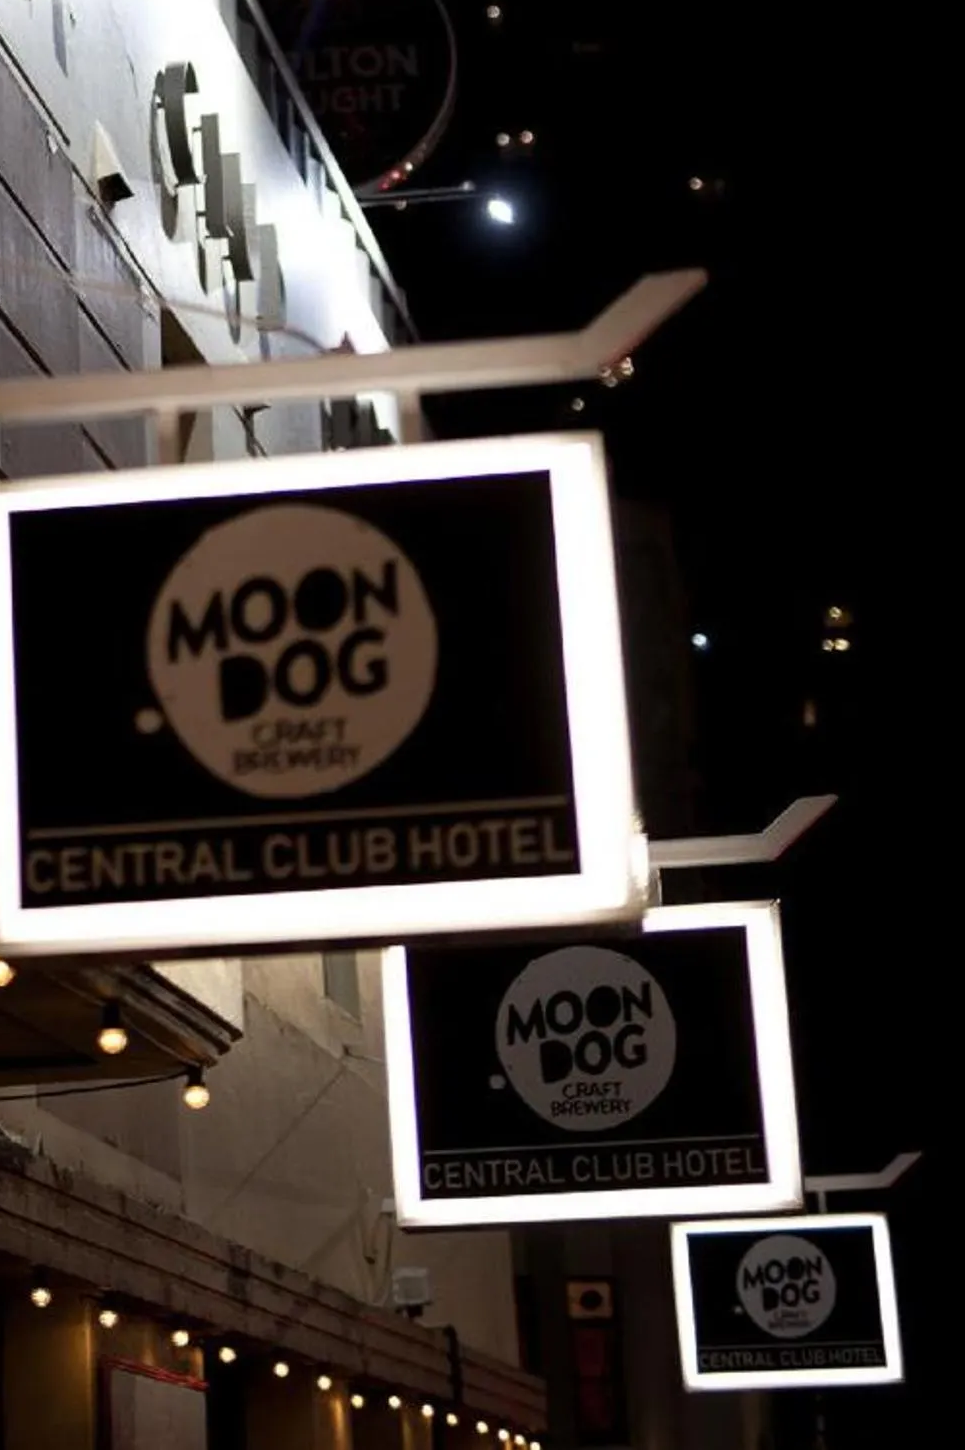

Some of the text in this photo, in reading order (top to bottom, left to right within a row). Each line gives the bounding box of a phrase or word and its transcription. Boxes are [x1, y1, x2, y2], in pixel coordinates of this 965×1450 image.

[167, 560, 400, 664] MOON
[220, 627, 388, 723] DOG
[252, 716, 347, 749] CRAFT
[231, 744, 362, 775] BREWERY
[26, 817, 574, 893] CENTRAL CLUB HOTEL
[507, 981, 653, 1046] MOON
[539, 1023, 647, 1084] DOG
[549, 1098, 632, 1117] BREWERY
[561, 1080, 623, 1100] CRAFT
[423, 1146, 765, 1190] CENTRAL CLUB HOTEL
[743, 1255, 822, 1290] MOON
[762, 1279, 820, 1312] DOG
[700, 1347, 883, 1369] CENTRAL CLUB HOTEL
